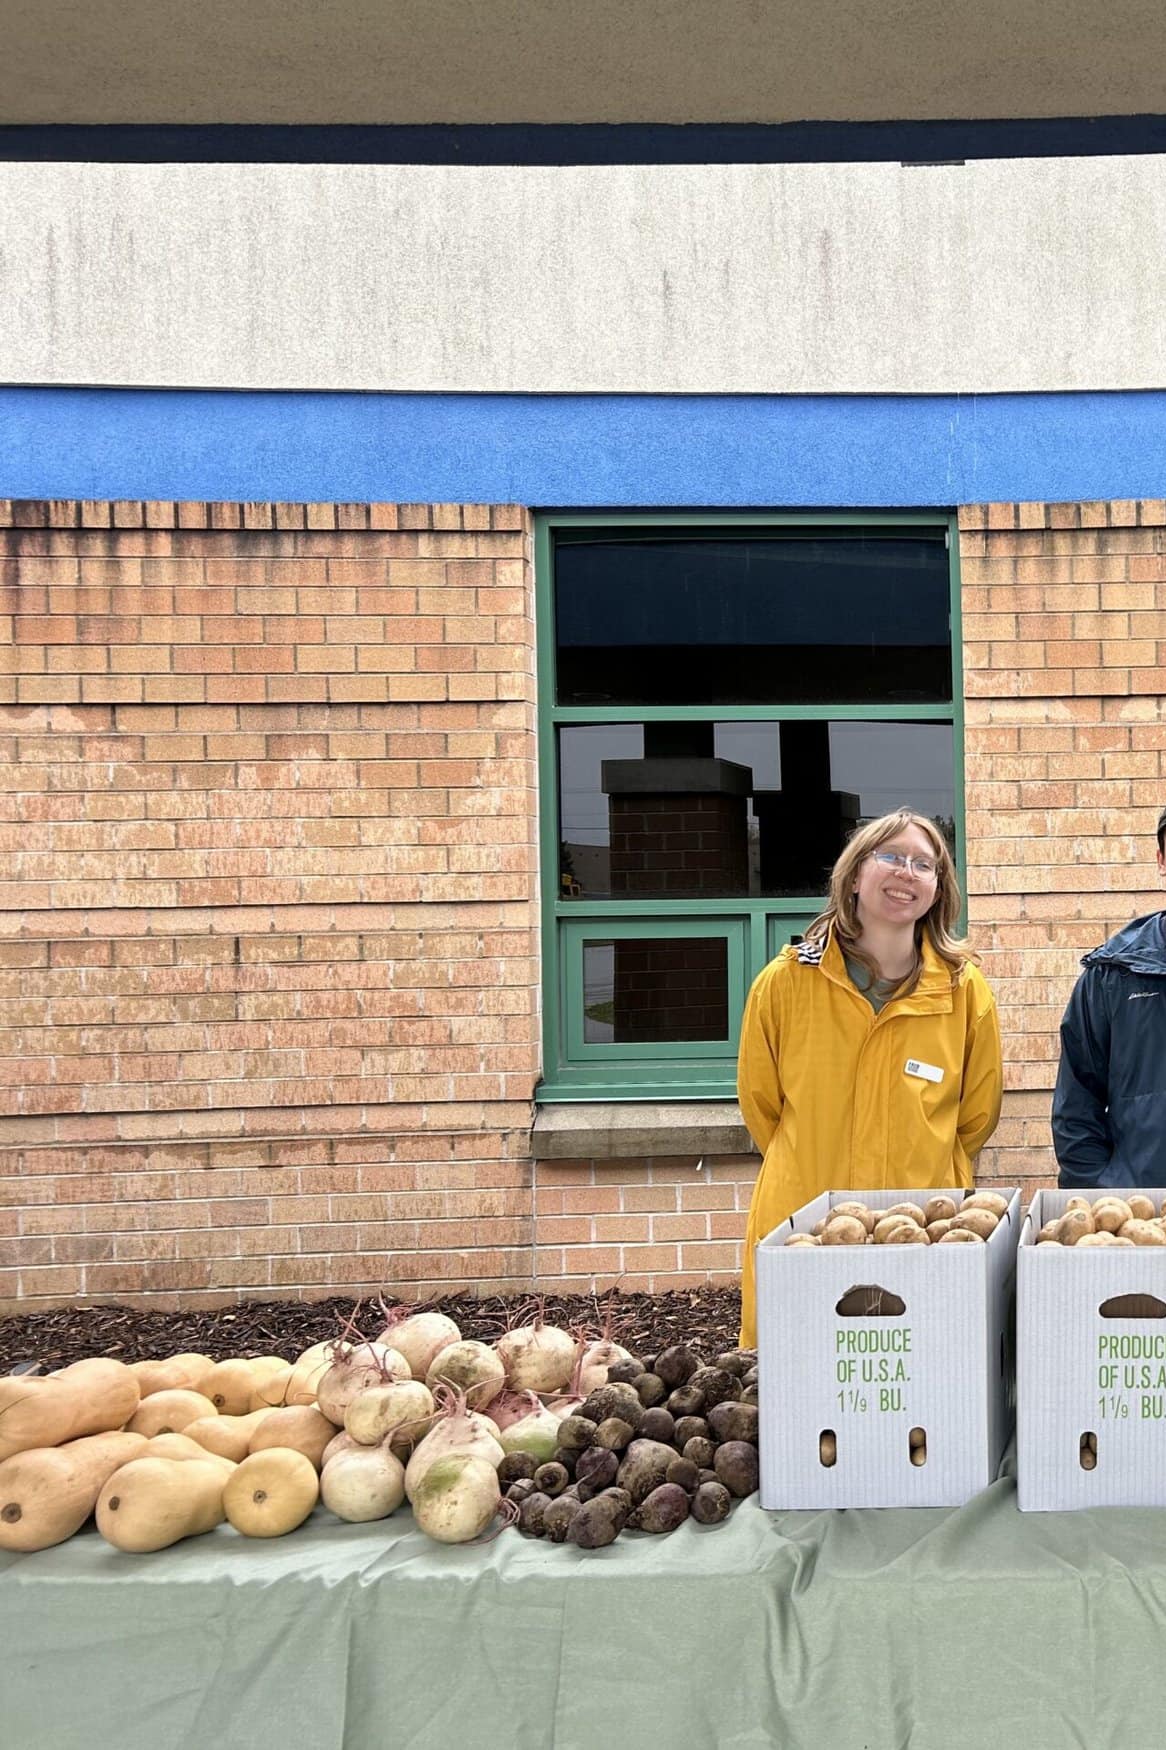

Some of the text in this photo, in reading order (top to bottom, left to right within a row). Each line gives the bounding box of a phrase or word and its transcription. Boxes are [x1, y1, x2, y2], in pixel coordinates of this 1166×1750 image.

[836, 1328, 912, 1353] PRODUCE
[837, 1358, 911, 1383] OF U.S.A.
[1099, 1365, 1118, 1389] OF
[880, 1387, 906, 1411] BU.
